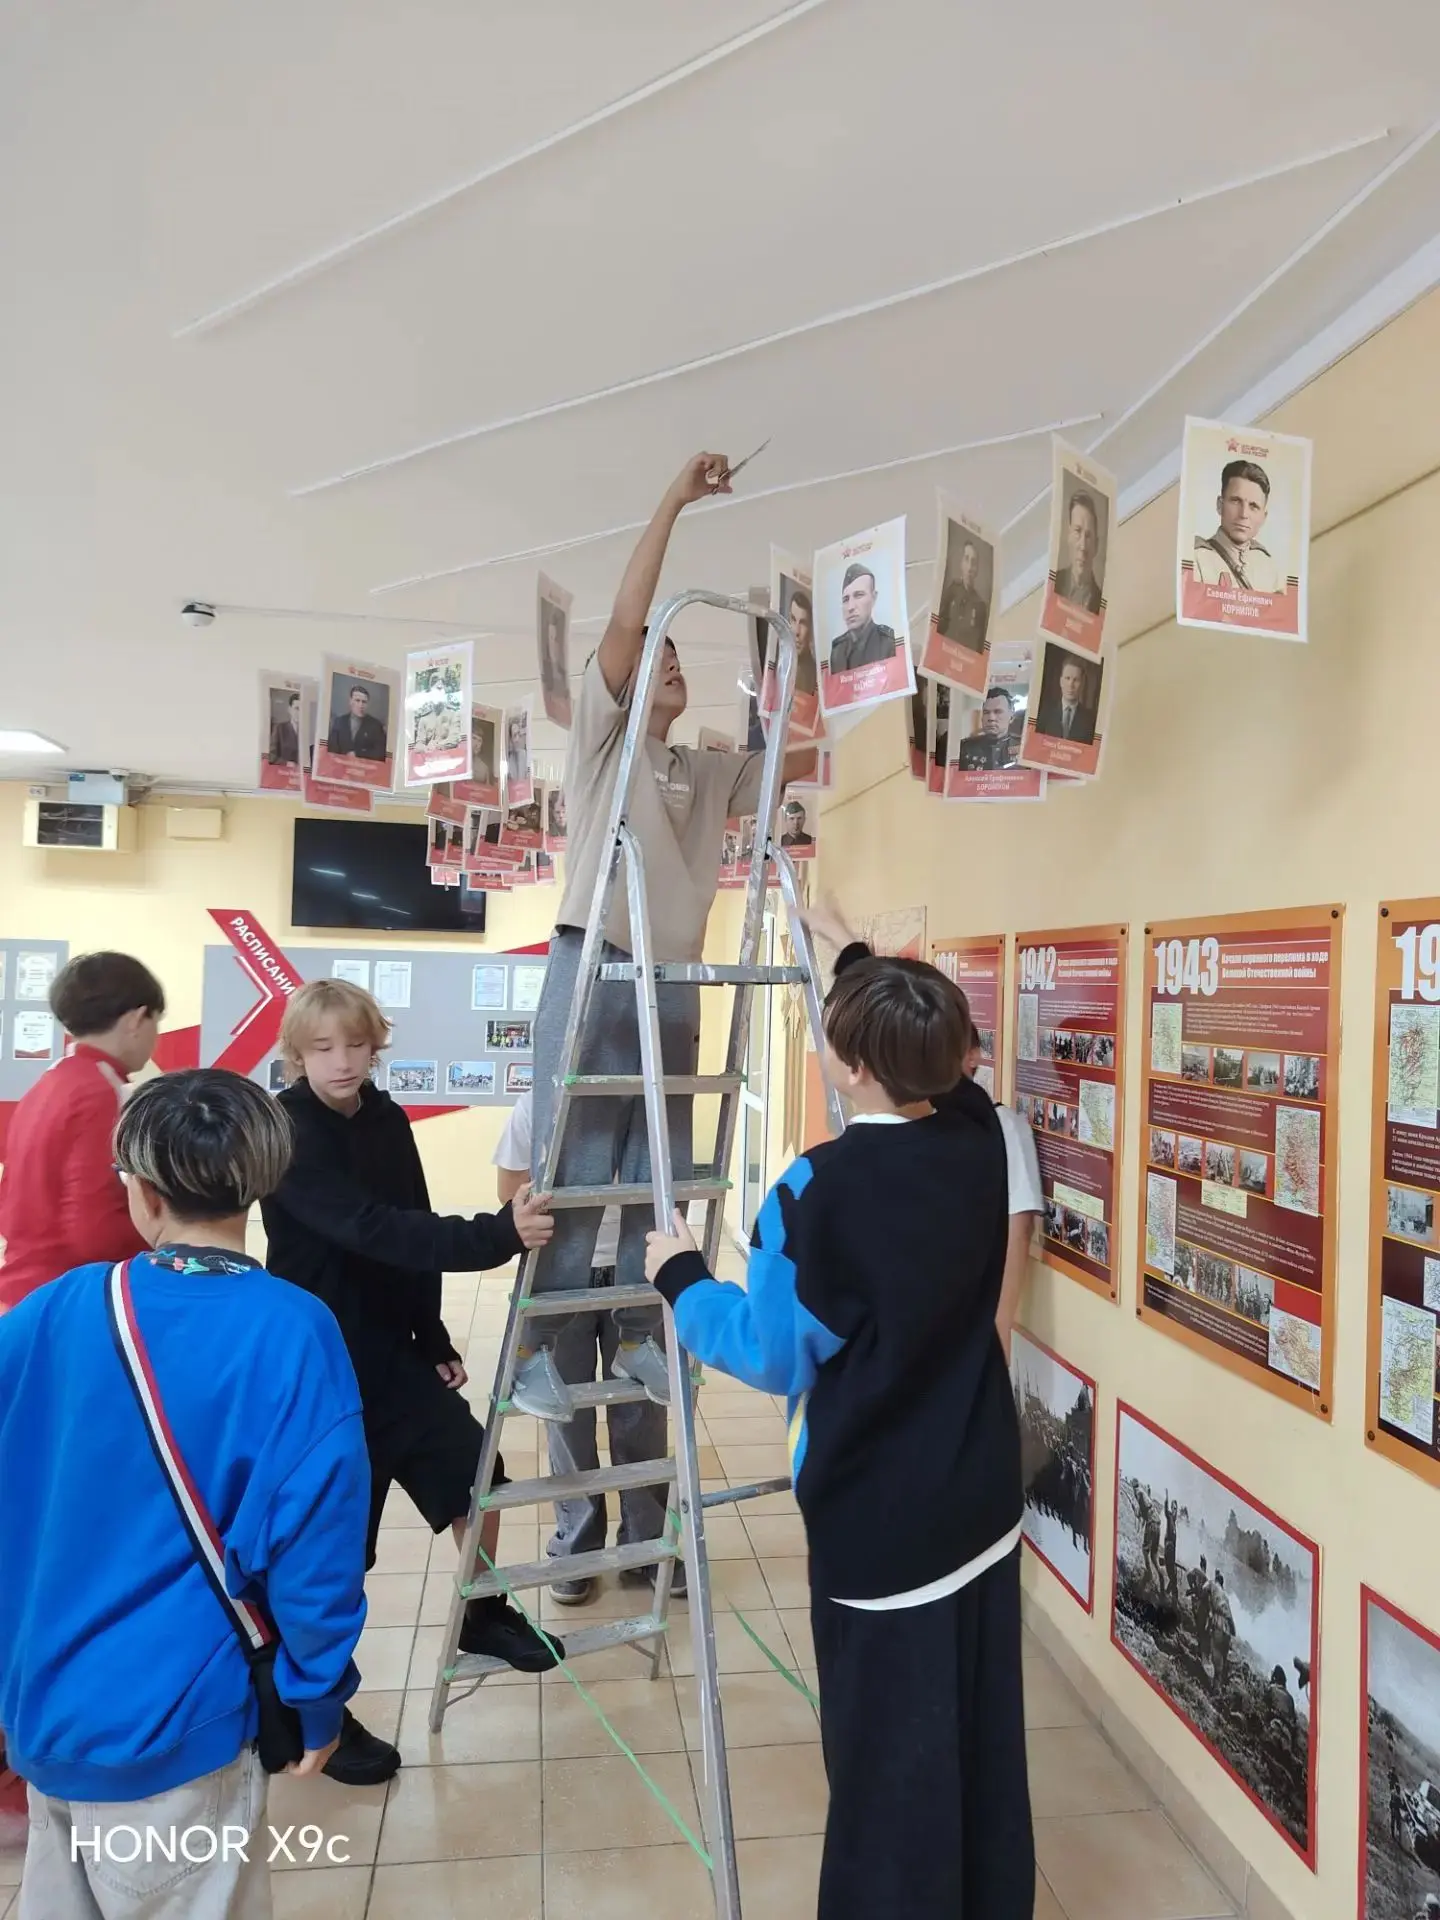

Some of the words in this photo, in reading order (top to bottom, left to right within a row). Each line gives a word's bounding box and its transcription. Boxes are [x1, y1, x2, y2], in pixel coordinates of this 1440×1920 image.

[1222, 603, 1260, 617] КОРНИЛОВ
[229, 916, 296, 996] РАСПИСАНИ
[1018, 946, 1056, 991] 1942
[1154, 937, 1219, 996] 1943
[1395, 924, 1440, 1001] 19
